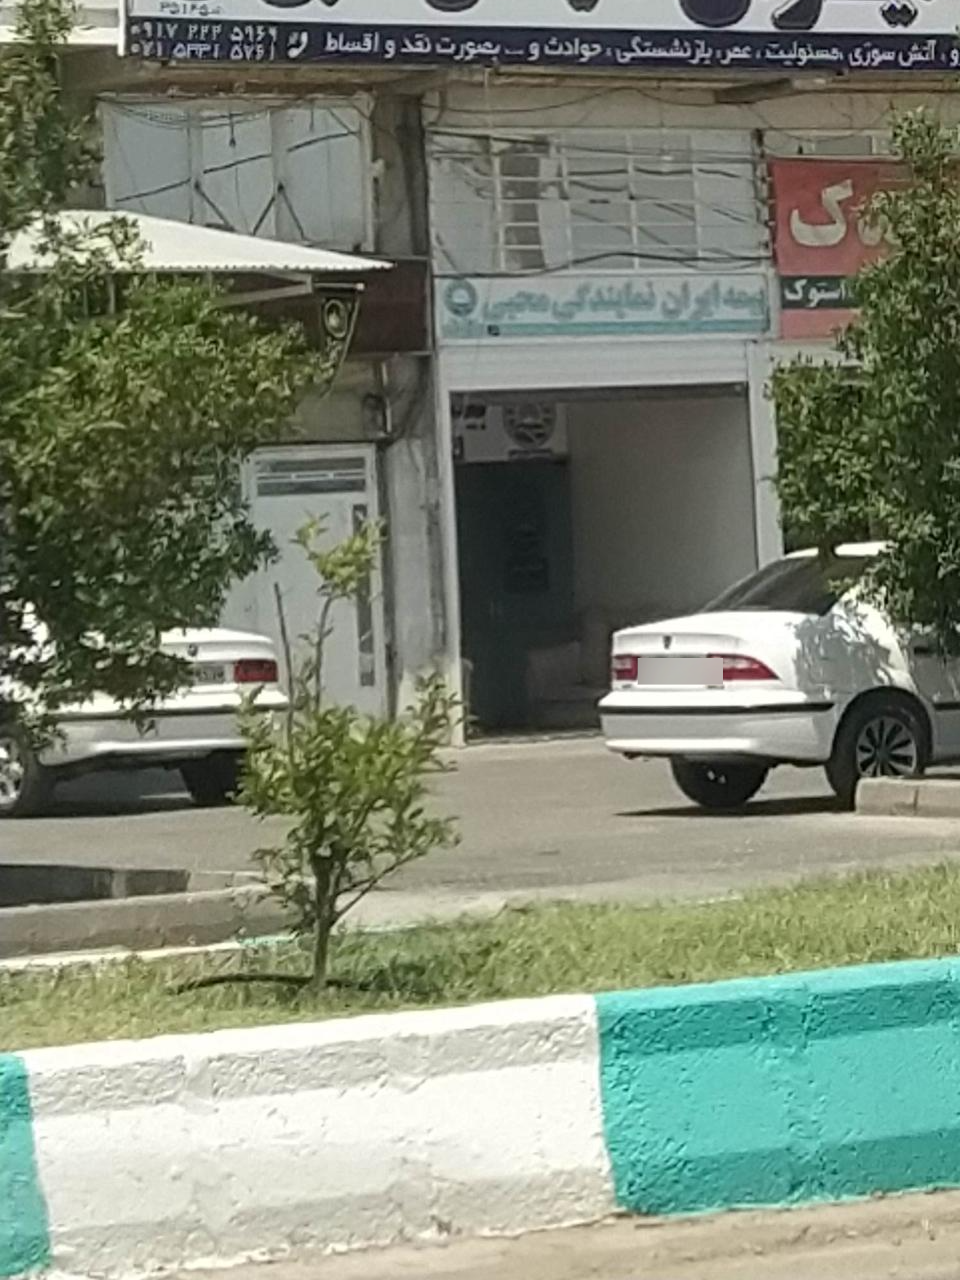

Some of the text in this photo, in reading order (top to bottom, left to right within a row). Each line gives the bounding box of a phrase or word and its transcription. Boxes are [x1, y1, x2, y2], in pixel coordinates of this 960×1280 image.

[324, 31, 380, 53] اقساط
[384, 38, 397, 59] و
[401, 33, 432, 54] نقد
